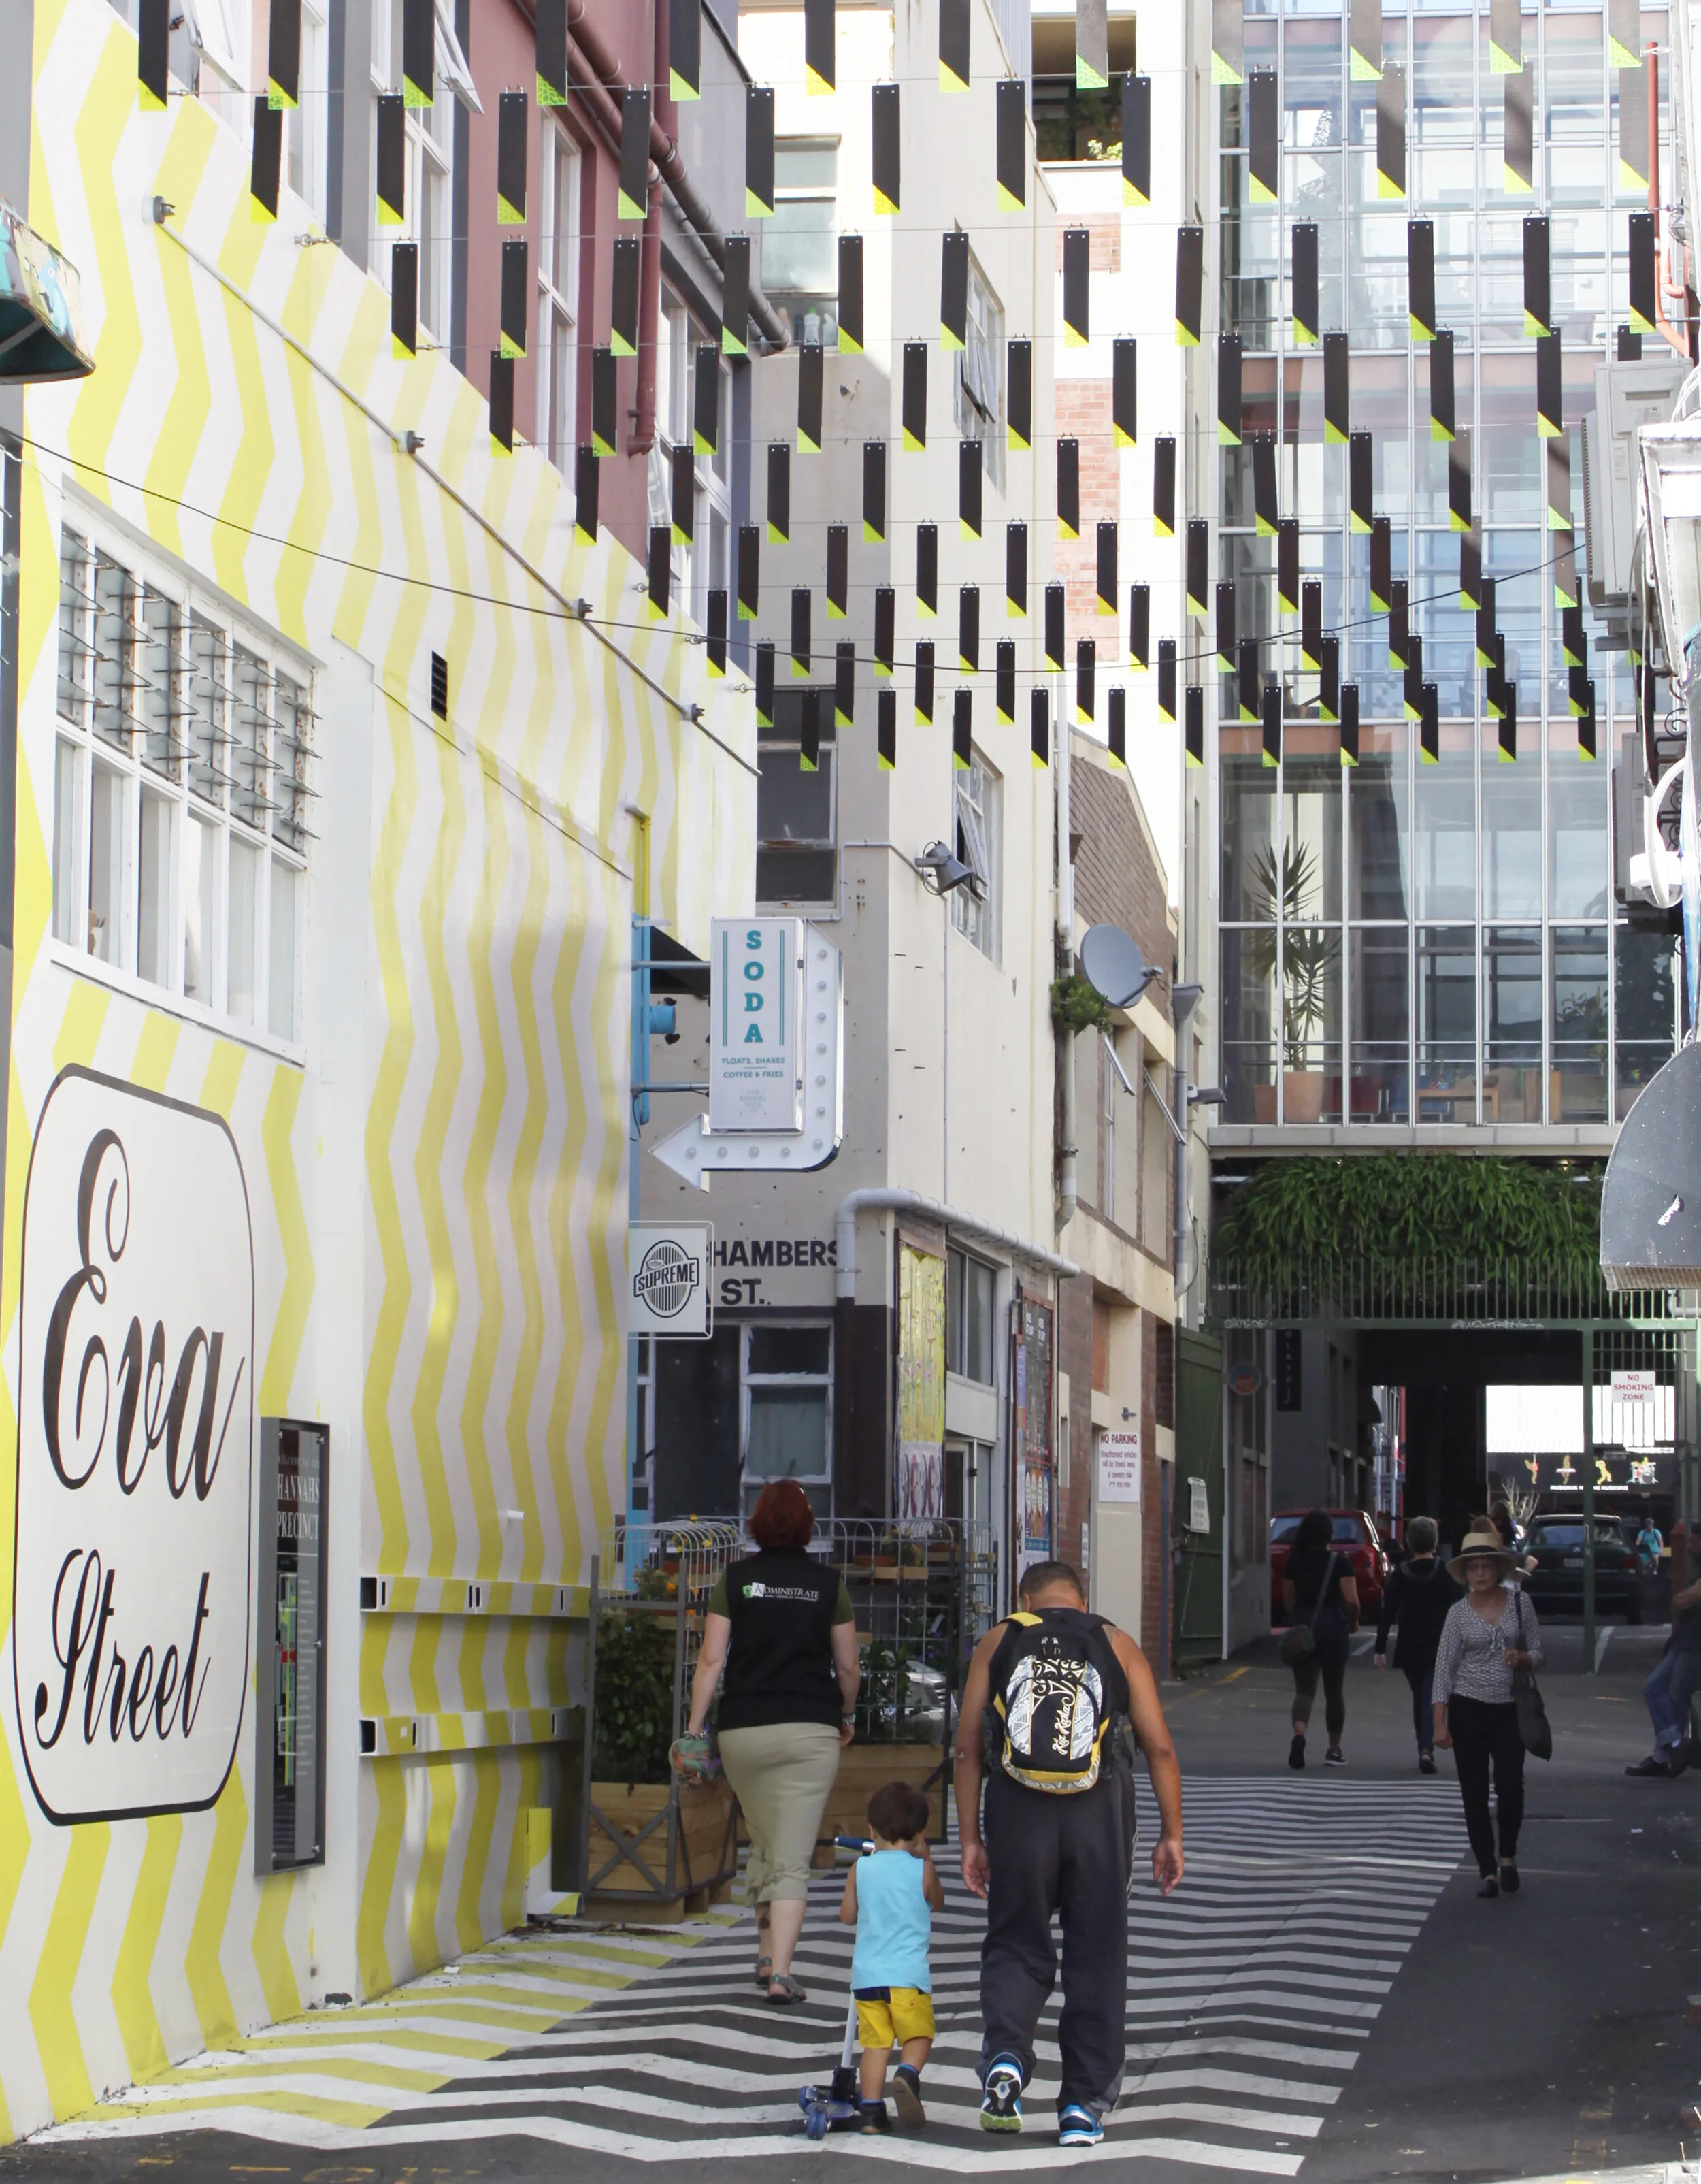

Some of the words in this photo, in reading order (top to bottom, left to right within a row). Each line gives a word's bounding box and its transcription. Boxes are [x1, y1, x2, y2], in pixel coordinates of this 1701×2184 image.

[744, 930, 764, 1043] SODA
[638, 1262, 695, 1292] SUPREME
[42, 1128, 245, 1502] Eva
[1100, 1434, 1109, 1444] NO
[1111, 1434, 1137, 1444] PARKING
[278, 1473, 320, 1503] HANNAHS
[277, 1512, 319, 1540] PRECINCT
[754, 1584, 819, 1599] ADMINISTRATE
[35, 1549, 211, 1750] Street
